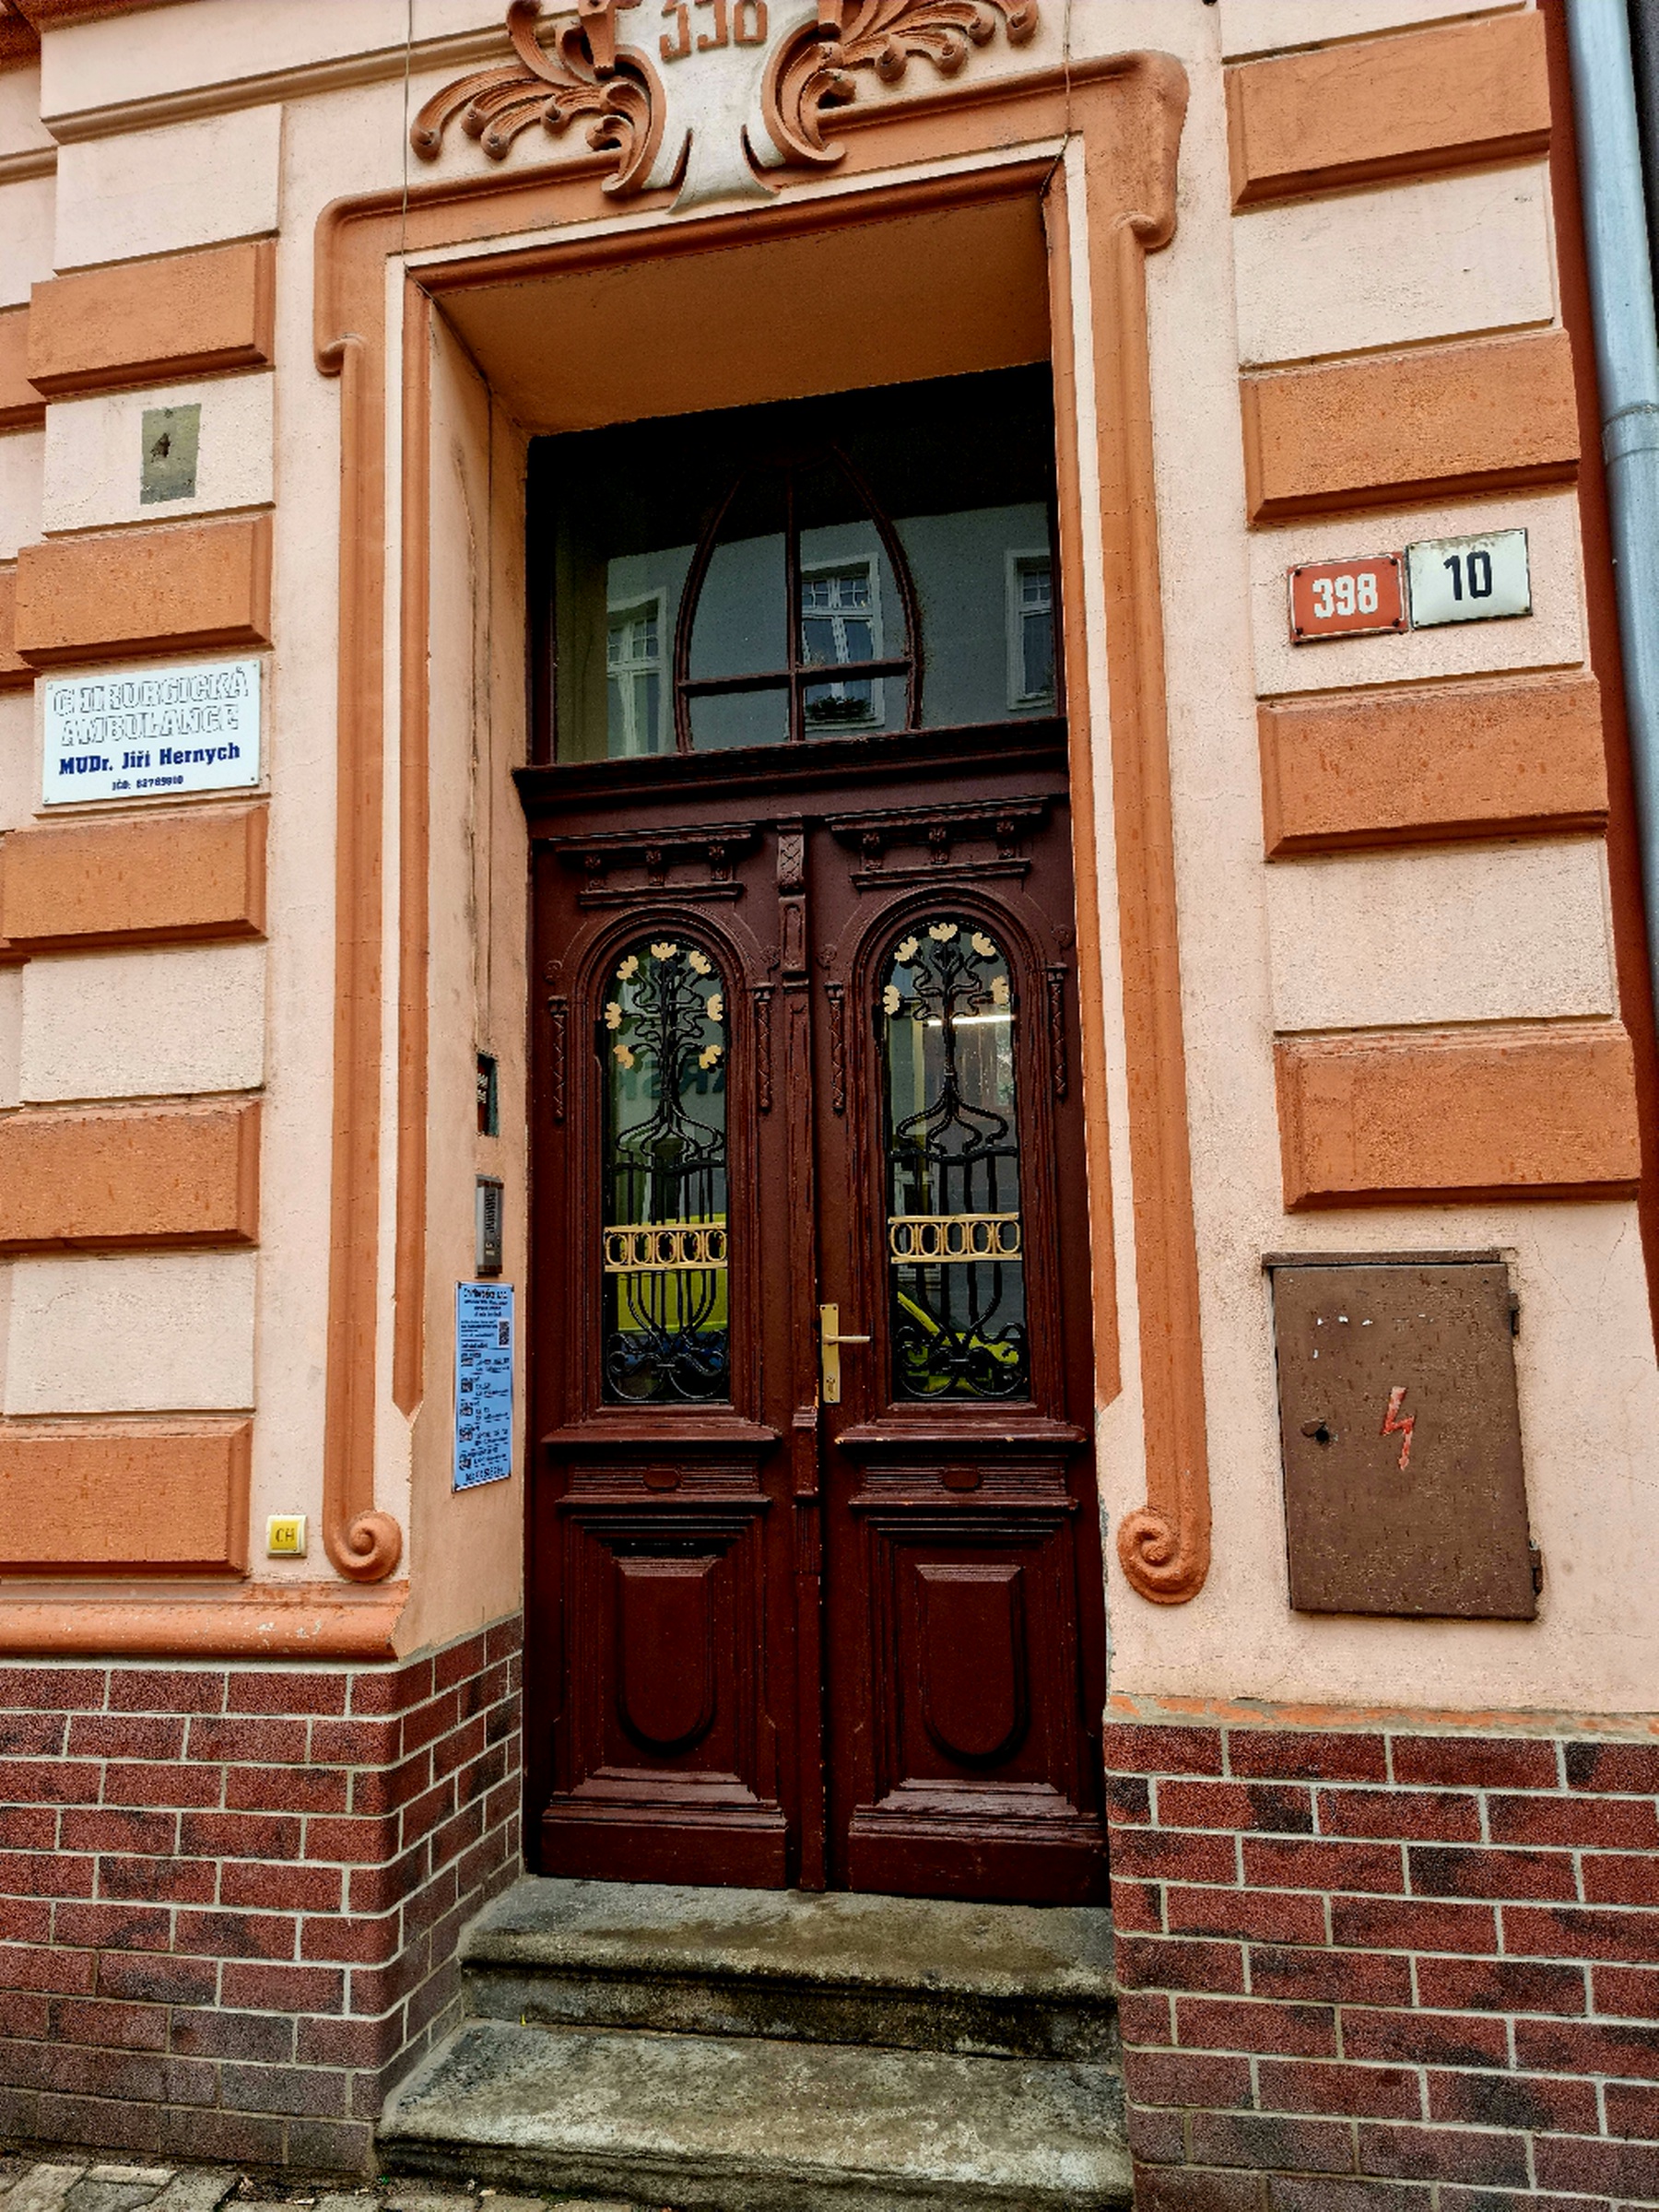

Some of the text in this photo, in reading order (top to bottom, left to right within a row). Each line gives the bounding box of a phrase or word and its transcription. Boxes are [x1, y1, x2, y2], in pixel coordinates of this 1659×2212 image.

[1312, 572, 1379, 618] 398
[1442, 550, 1493, 601] 10
[61, 703, 239, 747] AMBULANCE
[58, 742, 241, 776] MUDr. Jiří Hernych
